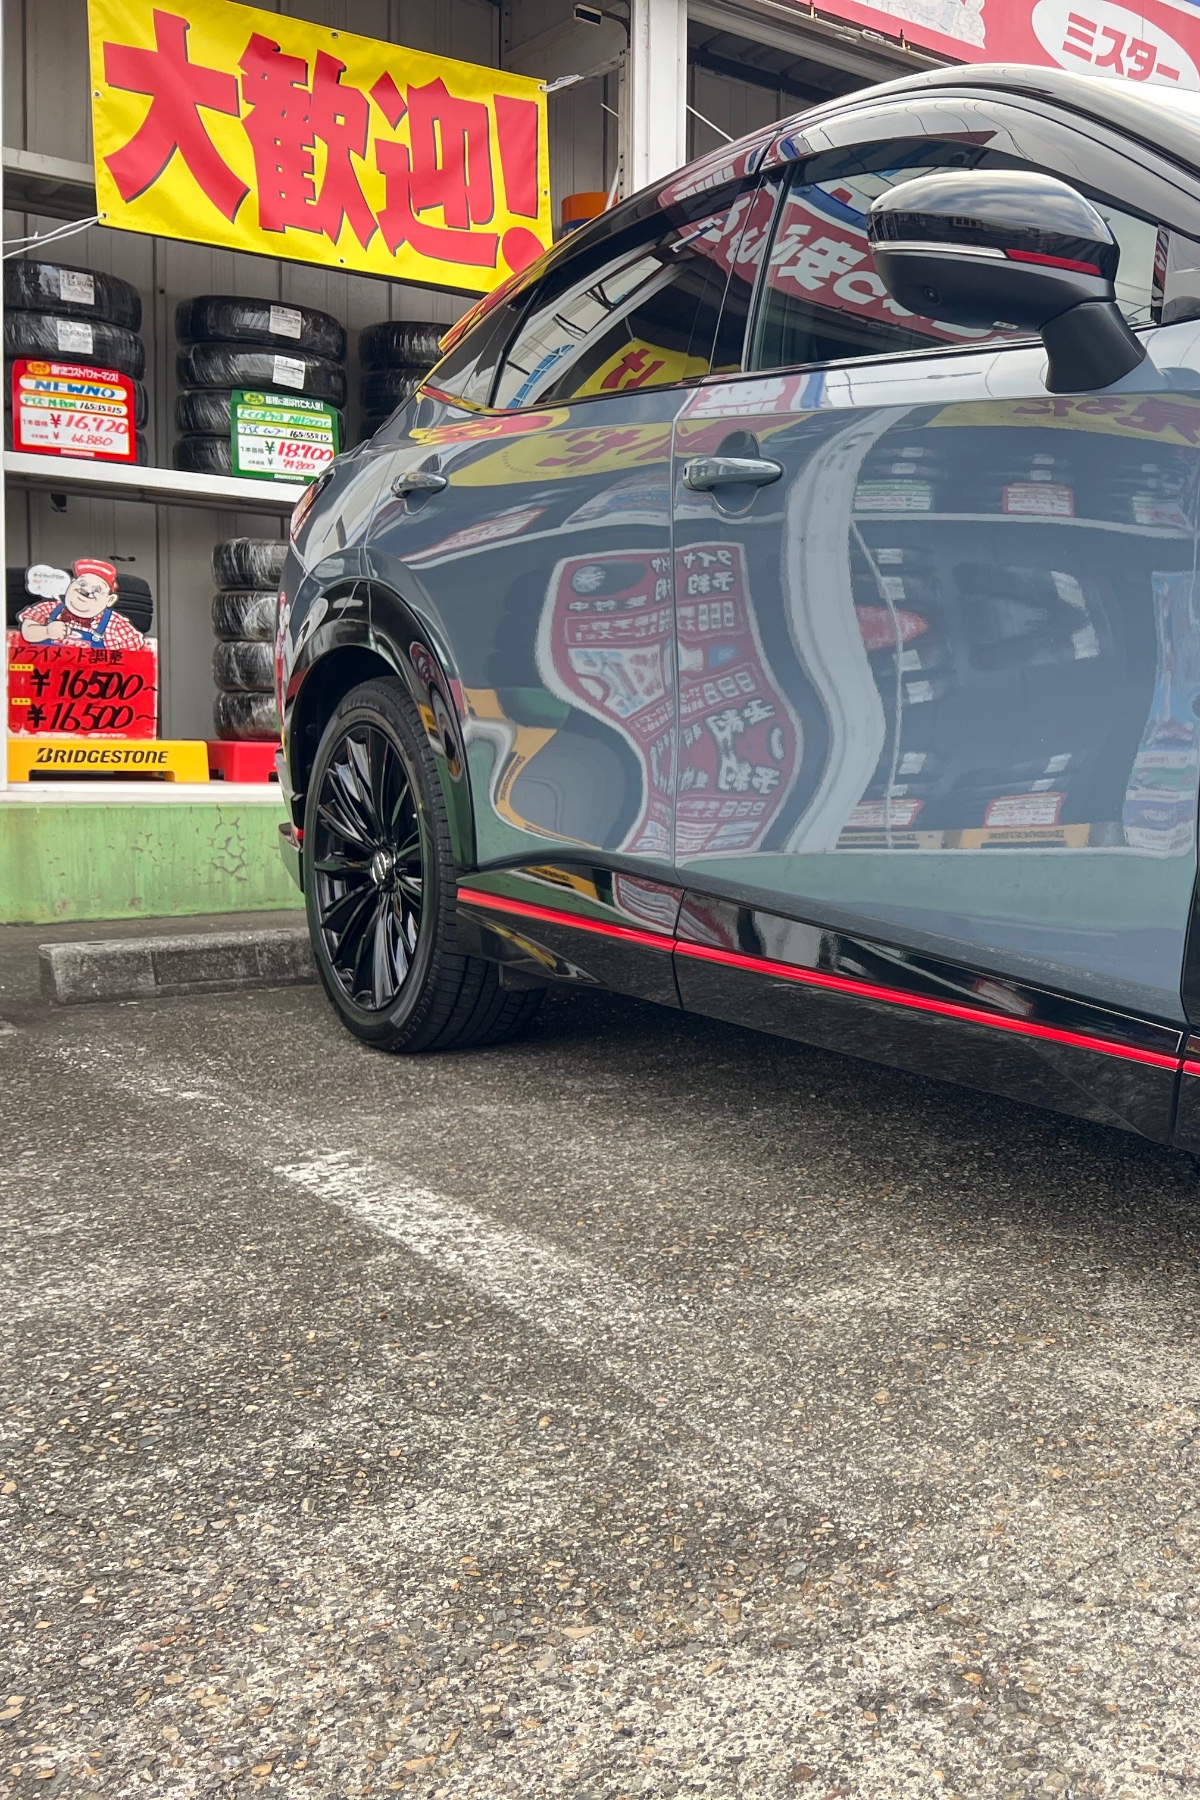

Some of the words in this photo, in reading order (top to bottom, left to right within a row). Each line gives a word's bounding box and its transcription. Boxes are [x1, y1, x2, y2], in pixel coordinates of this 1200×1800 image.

[1062, 12, 1181, 83] ミスター
[102, 8, 547, 274] 大歓迎!
[35, 747, 169, 764] BRIDGESTONE
